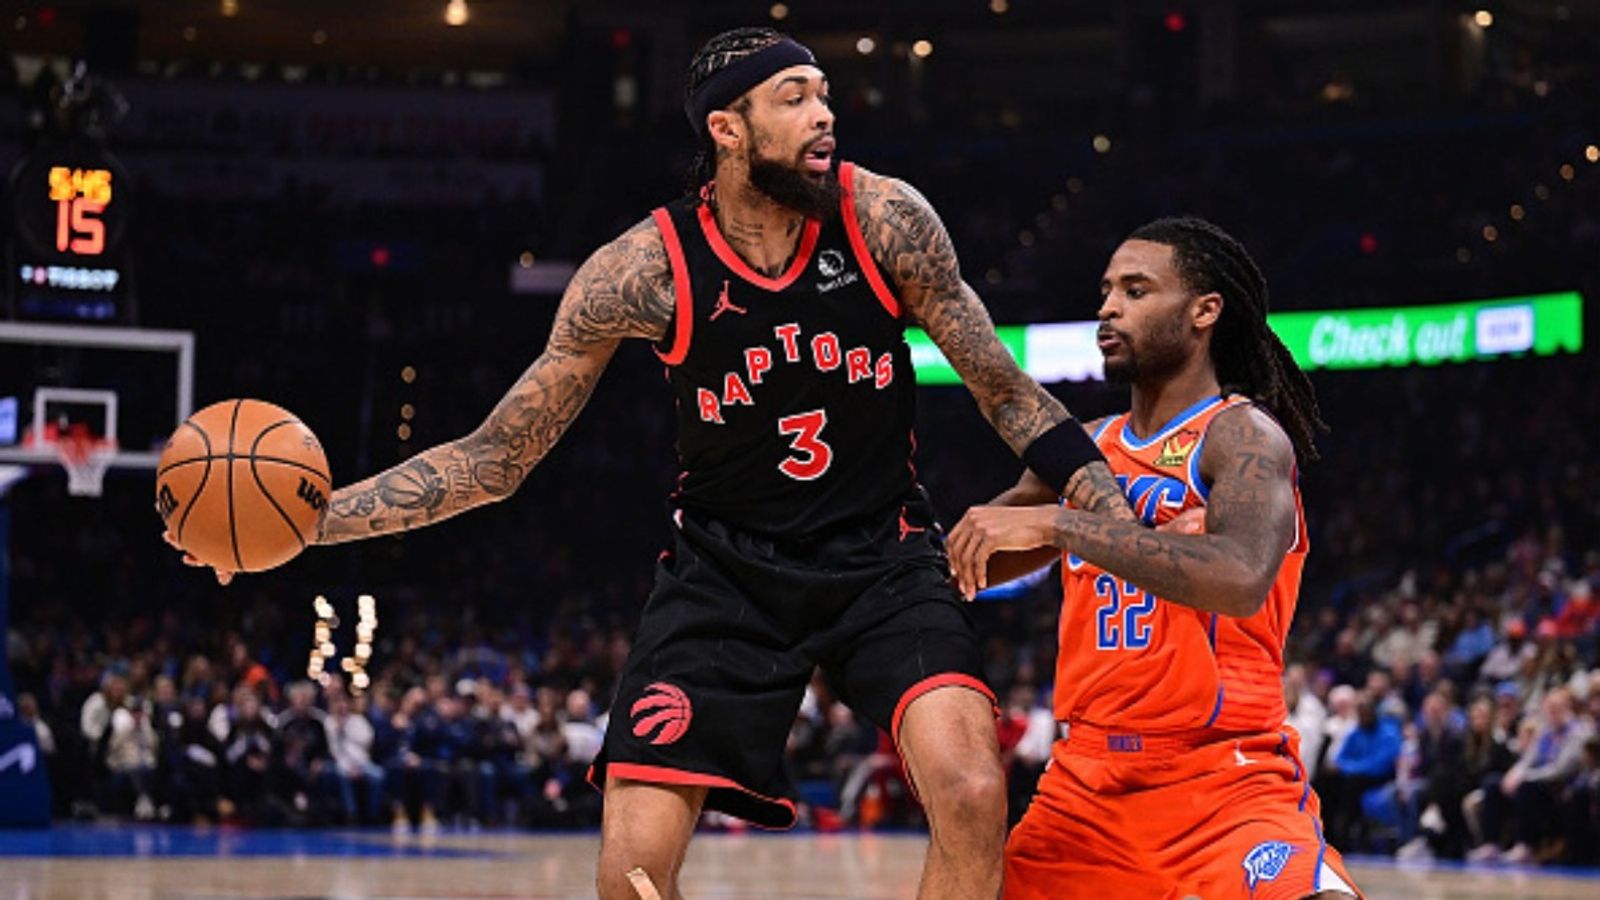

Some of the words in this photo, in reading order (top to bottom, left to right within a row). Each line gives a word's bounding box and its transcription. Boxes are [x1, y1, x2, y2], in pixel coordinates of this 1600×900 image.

[57, 197, 105, 255] 15
[697, 323, 893, 424] RAPTORS
[1309, 314, 1409, 367] Check
[1416, 310, 1468, 360] out
[778, 409, 832, 480] 3
[1095, 571, 1156, 650] 22
